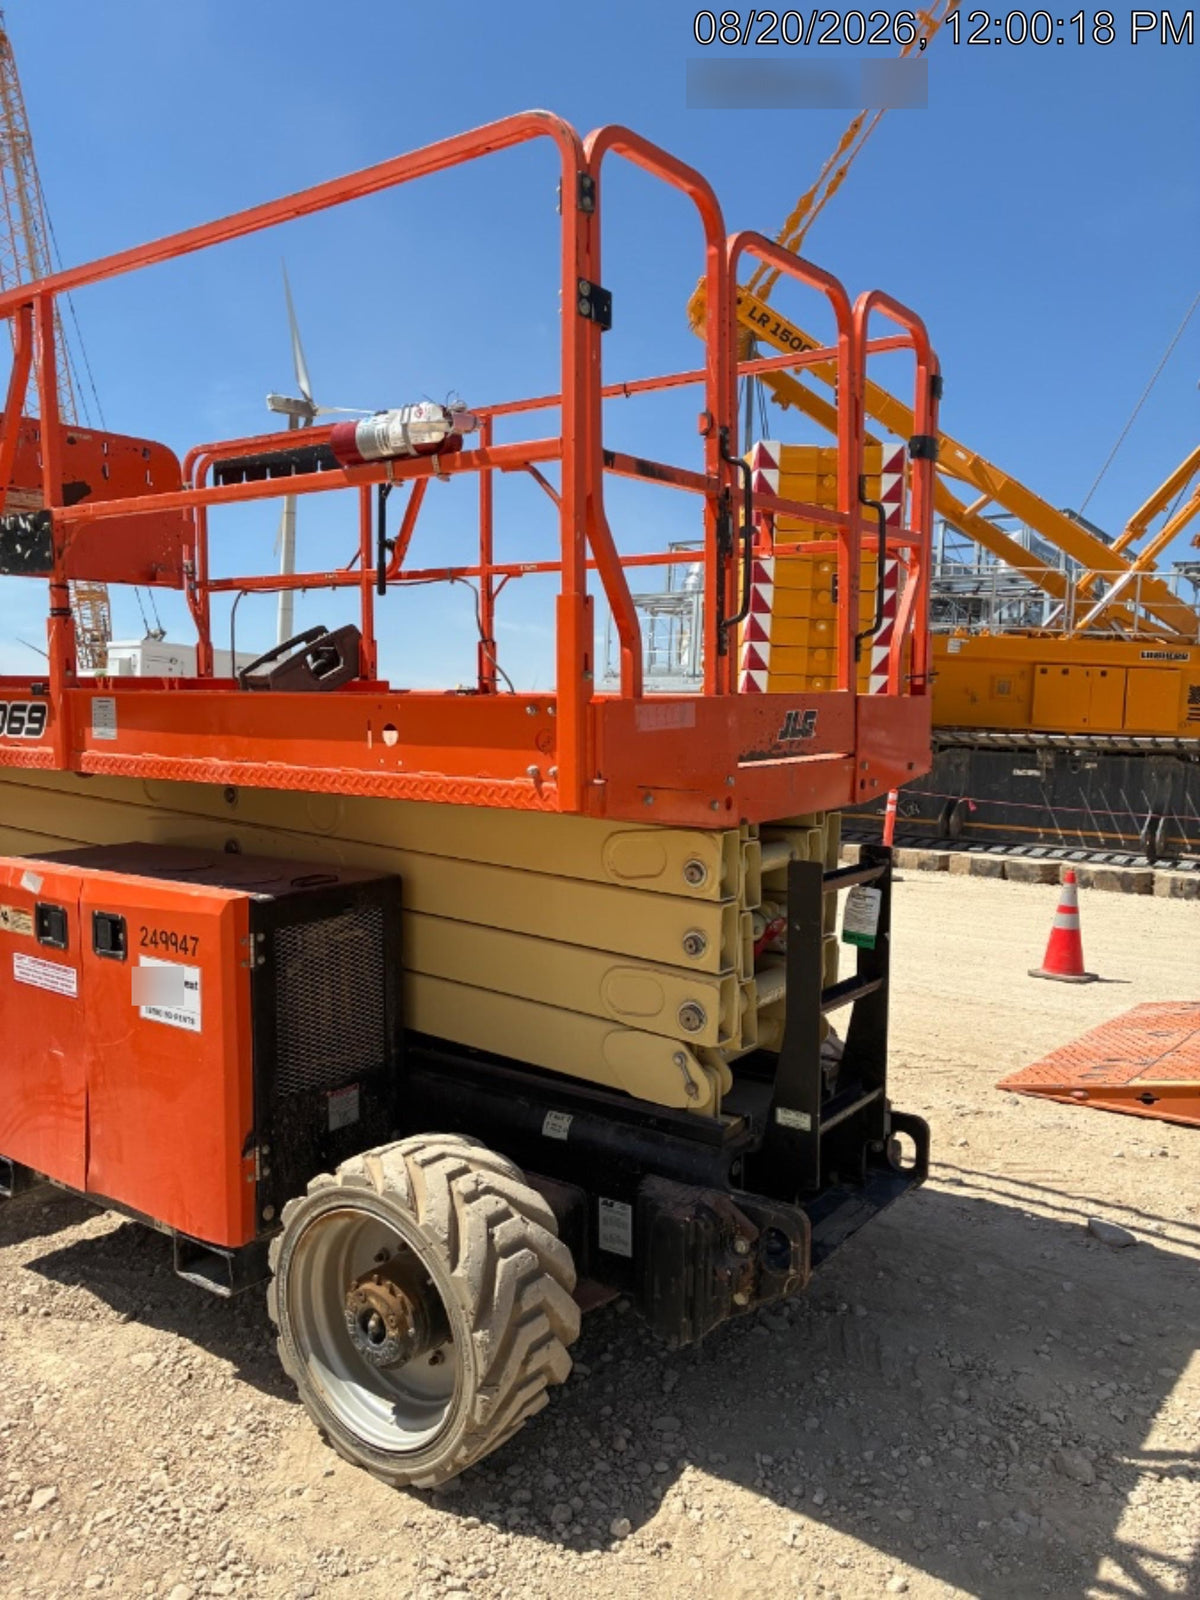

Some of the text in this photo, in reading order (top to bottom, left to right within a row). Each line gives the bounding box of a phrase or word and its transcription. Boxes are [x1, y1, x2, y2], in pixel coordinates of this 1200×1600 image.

[748, 306, 771, 327] LR
[777, 709, 818, 741] JLG
[140, 926, 199, 956] 249947
